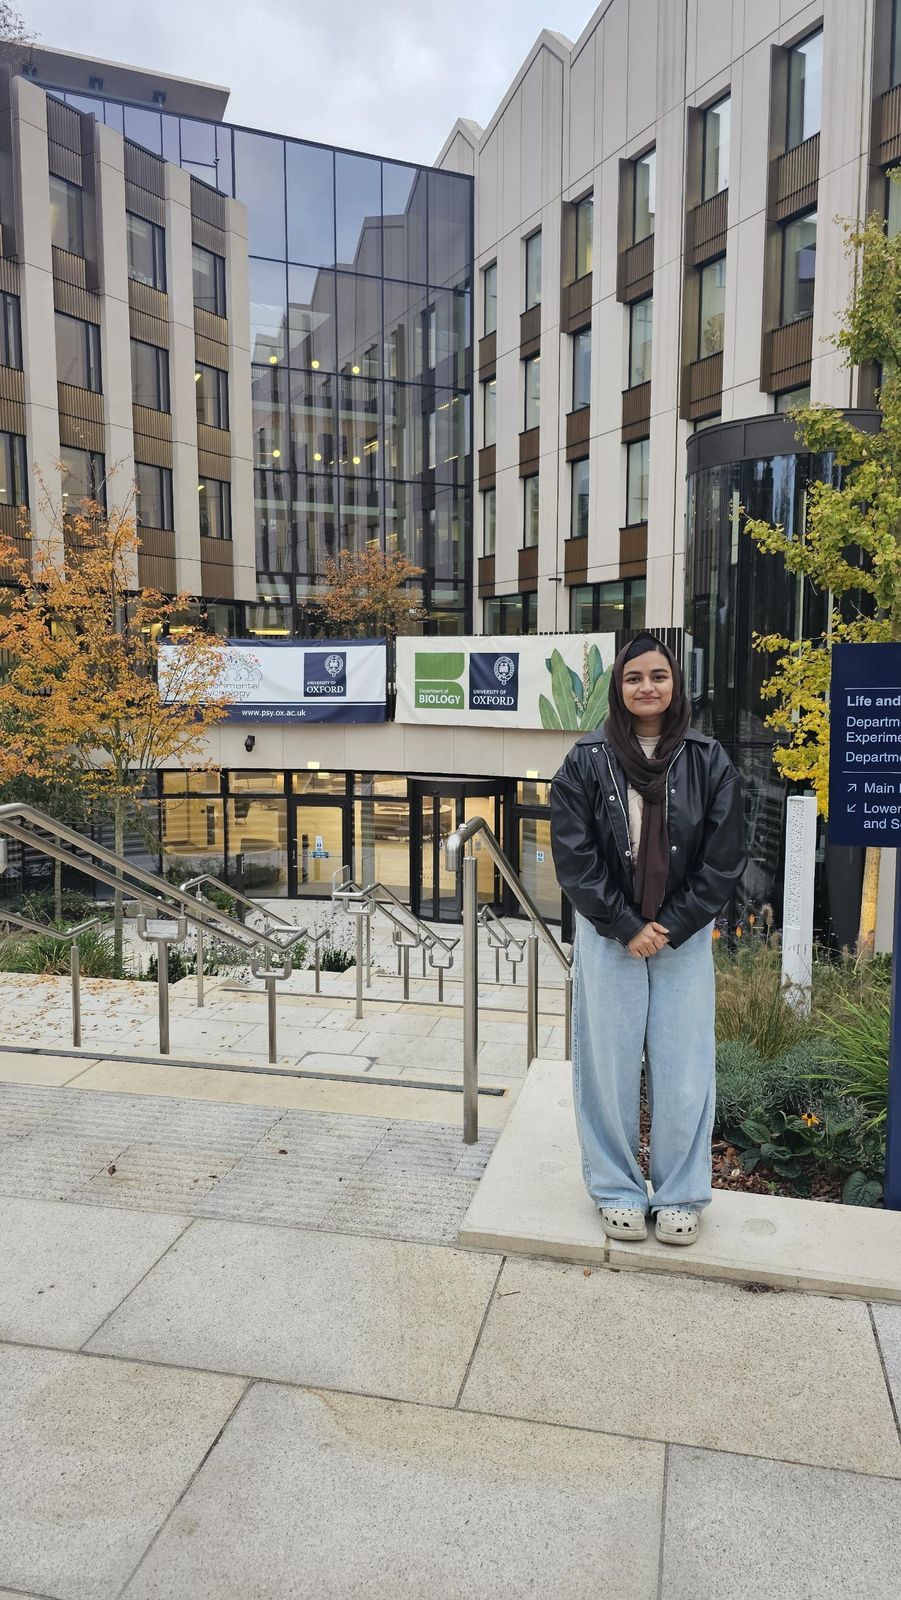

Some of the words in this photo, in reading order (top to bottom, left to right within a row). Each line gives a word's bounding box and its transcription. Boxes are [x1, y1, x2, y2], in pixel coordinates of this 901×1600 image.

[306, 685, 344, 694] OXFORD
[418, 694, 461, 705] BIOLOGY
[472, 695, 515, 706] OXFORD
[846, 695, 872, 707] Life
[875, 695, 901, 707] and
[241, 709, 307, 718] www.psy.ox.ac.uk
[846, 716, 901, 729] Departm
[845, 752, 901, 765] Departm
[864, 783, 895, 794] Main
[863, 818, 887, 829] and
[890, 818, 901, 829] S
